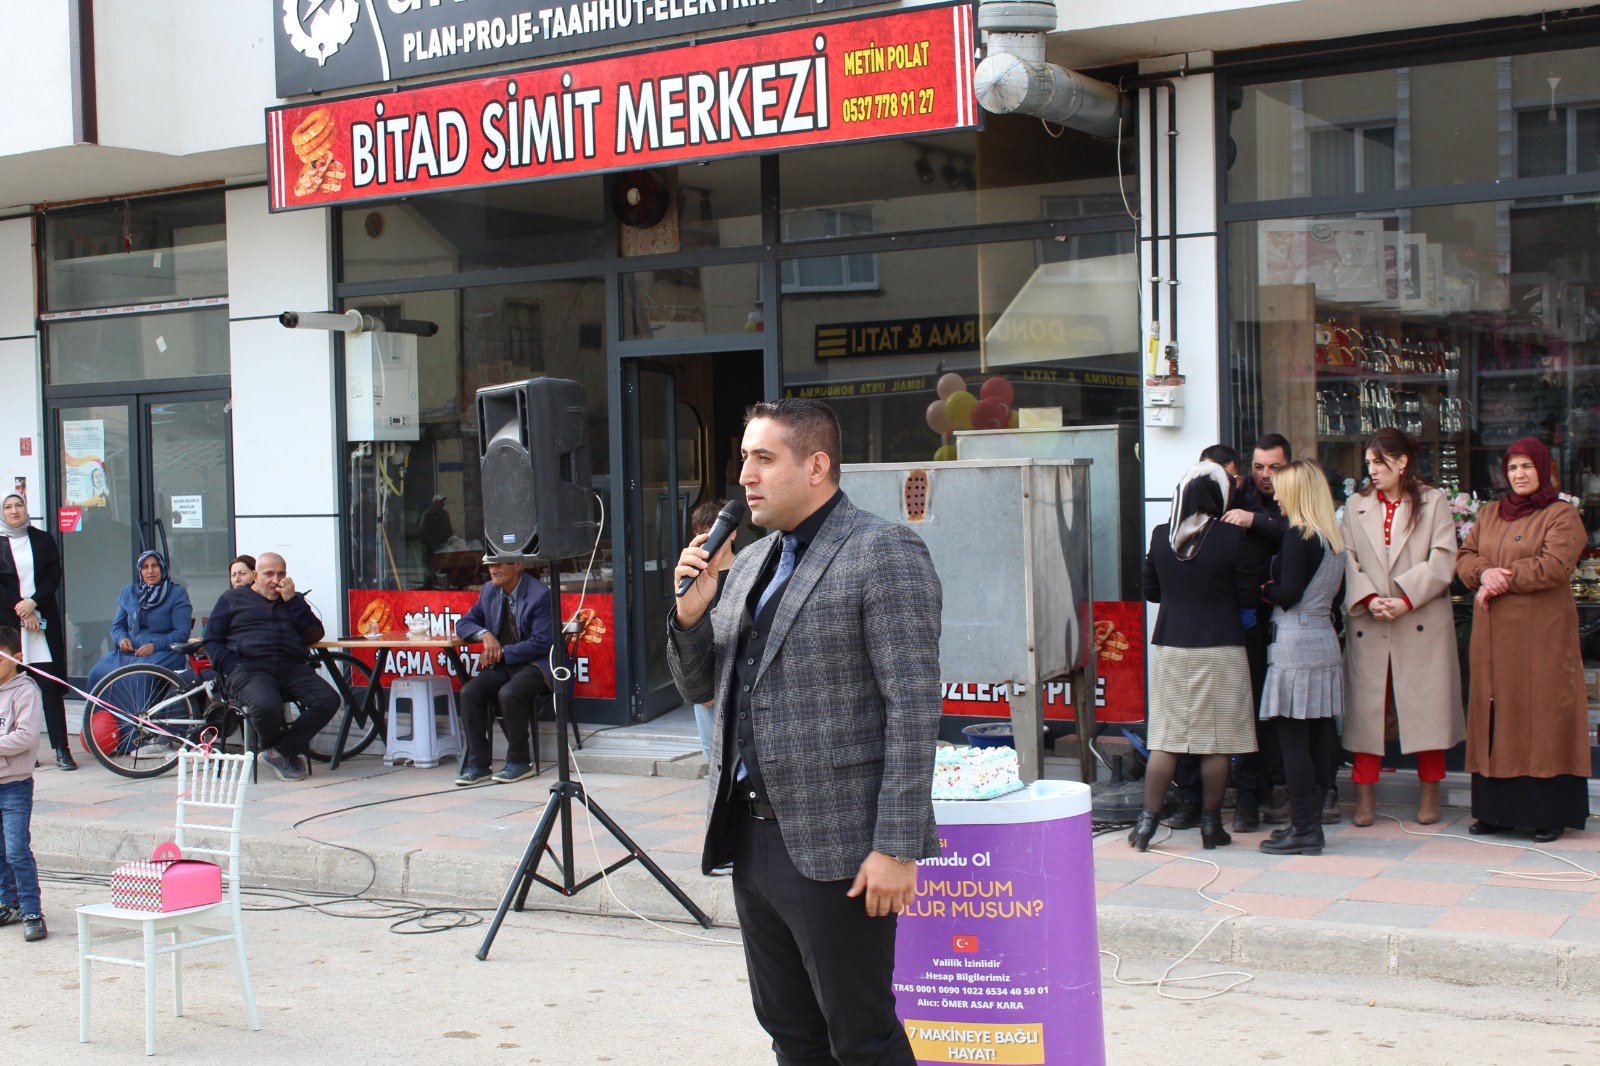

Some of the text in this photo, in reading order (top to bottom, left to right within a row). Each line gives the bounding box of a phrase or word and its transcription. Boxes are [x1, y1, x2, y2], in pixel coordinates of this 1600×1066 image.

[844, 40, 930, 76] METİN POLAT
[351, 34, 829, 188] BİTAD SİMİT MERKEZİ
[842, 87, 935, 123] 0537 778 91 27
[972, 852, 991, 867] Ol
[914, 880, 1013, 898] UMUDUM
[951, 899, 1044, 918] MUSUN?
[932, 957, 1002, 969] Valilik İzinlidir
[925, 971, 1011, 984] Hesap Bilgilerimiz
[894, 983, 1049, 995] TR45 0001 0090 1022 6534 40 50 01
[917, 998, 1024, 1010] Alıcı: ÖMER ASAF KARA
[908, 1026, 1039, 1044] 7 MAKİNEYE BAĞLI
[947, 1046, 997, 1061] HAYAT!
